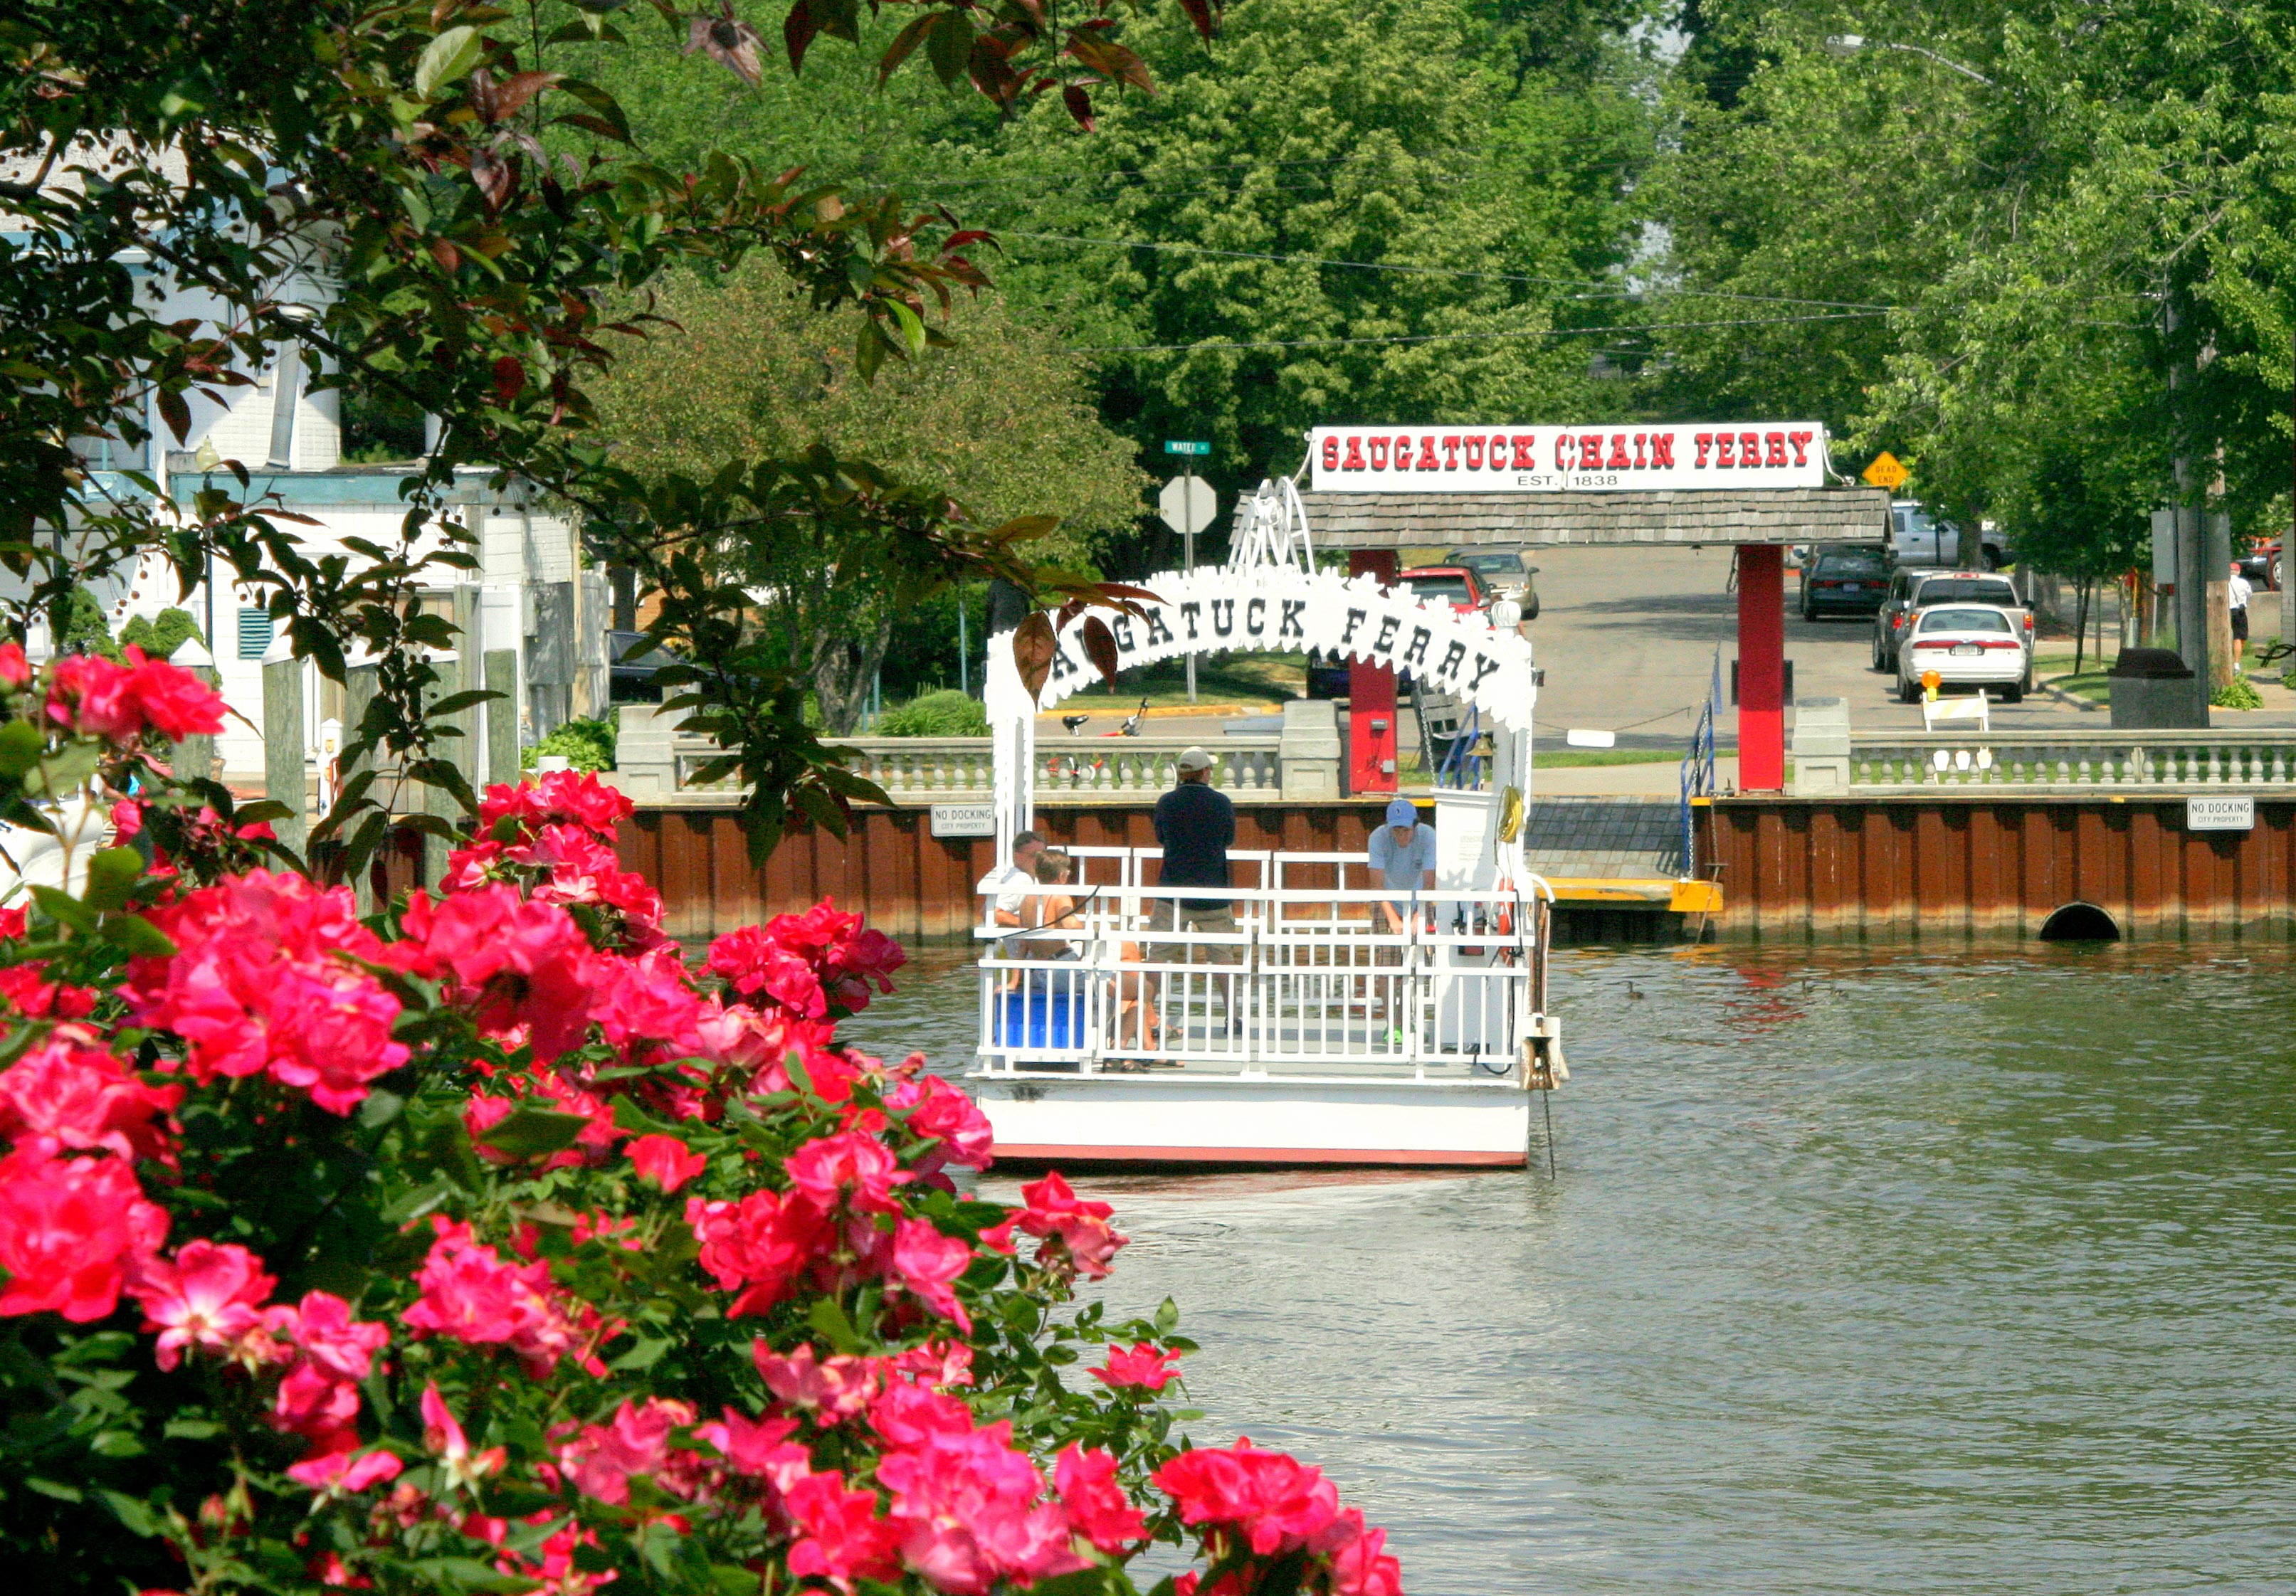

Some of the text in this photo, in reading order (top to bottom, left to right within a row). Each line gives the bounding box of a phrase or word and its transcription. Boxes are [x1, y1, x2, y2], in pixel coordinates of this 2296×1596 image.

[1171, 442, 1196, 452] WATER
[1322, 430, 1813, 472] SAUGATUCK CHAIN FERRY
[1517, 475, 1618, 487] EST. 1838
[1052, 597, 1500, 692] AGATUCK FERRY
[2192, 803, 2250, 813] NO DOCKING
[935, 810, 991, 820] NO DOCKING
